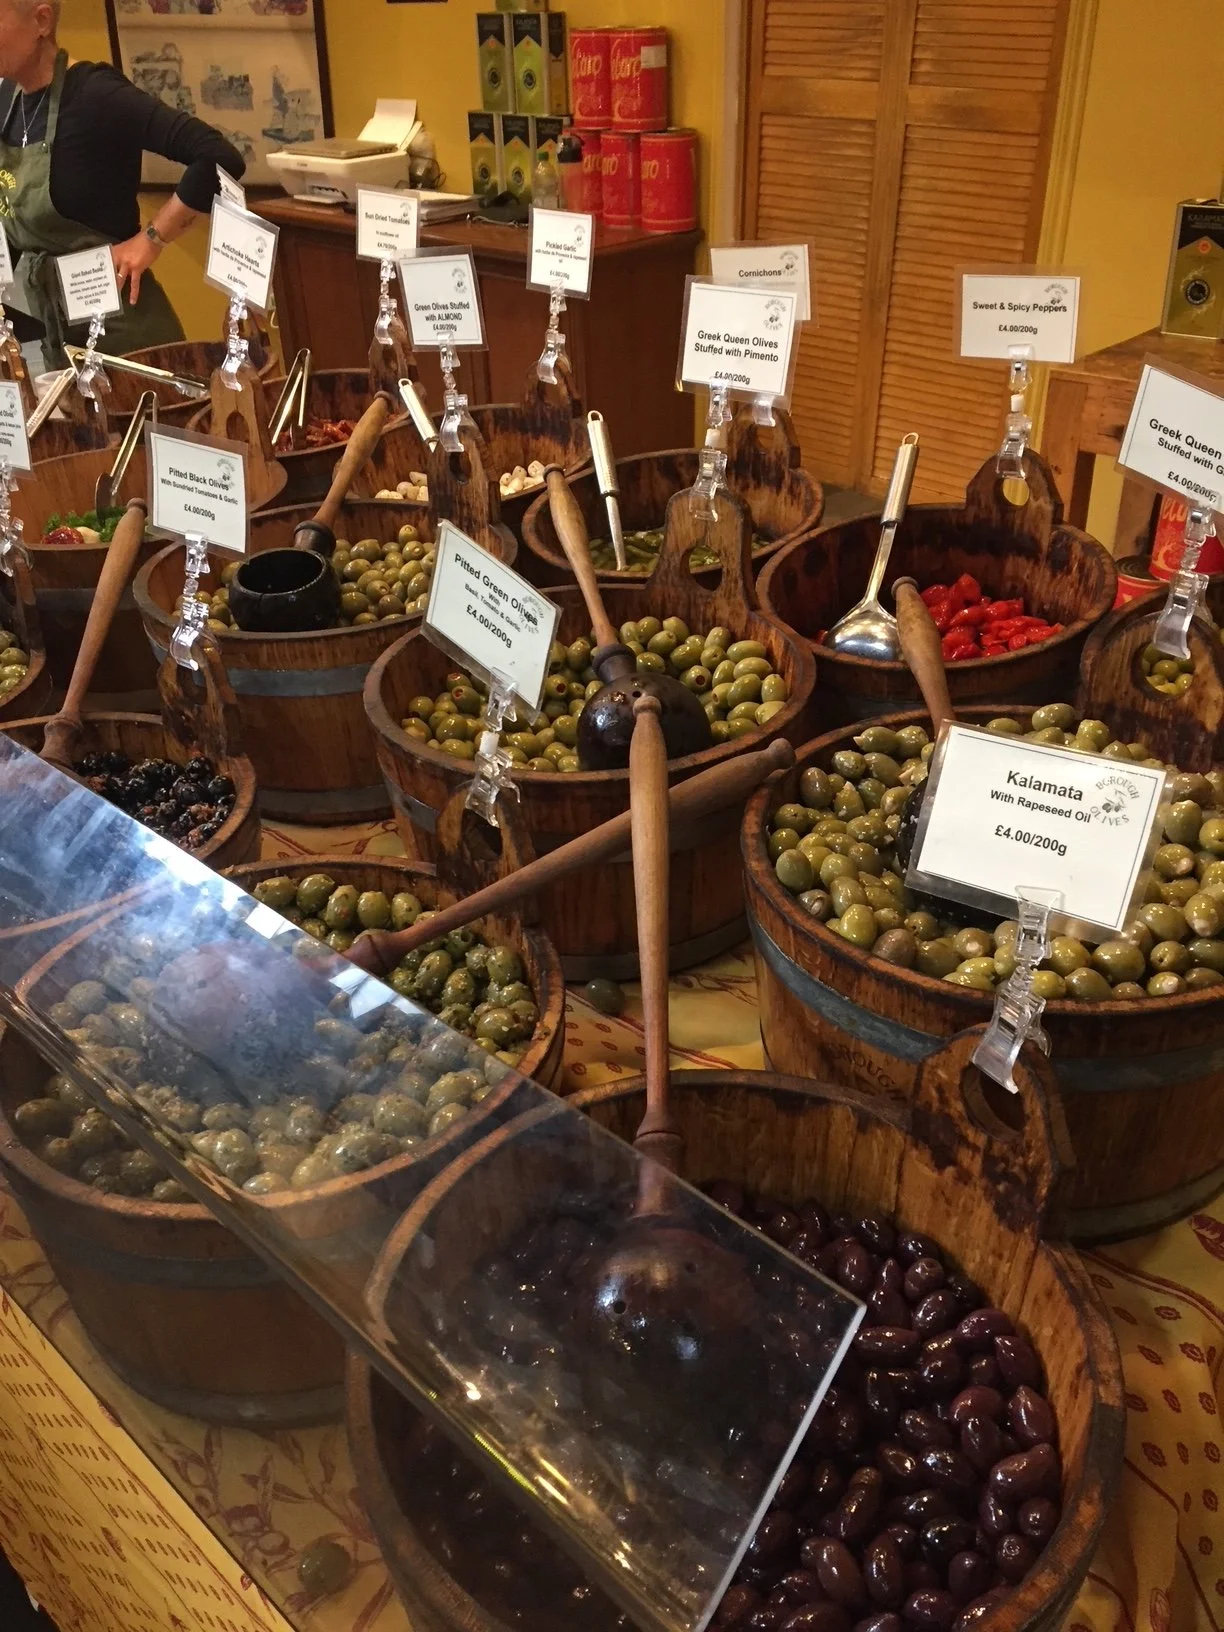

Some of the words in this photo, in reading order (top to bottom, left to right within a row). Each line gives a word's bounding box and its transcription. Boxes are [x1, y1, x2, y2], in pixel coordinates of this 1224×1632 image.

[375, 213, 387, 221] Dried
[388, 216, 410, 225] Tomatoes
[222, 242, 244, 259] Artichoke
[245, 254, 259, 268] Hearts
[546, 241, 562, 250] Pickled
[564, 244, 576, 252] Garlic
[738, 268, 782, 277] Cornichons
[449, 302, 470, 310] Stuffed
[972, 302, 997, 310] Sweet
[999, 302, 1005, 310] &
[1007, 302, 1030, 313] Spicy
[1033, 303, 1067, 313] Peppers
[438, 313, 462, 321] ALMOND
[697, 330, 721, 342] Greek
[723, 333, 749, 345] Queen
[752, 337, 778, 349] Olives
[998, 325, 1038, 335] £4.00/200g
[694, 342, 723, 355] Stuffed
[725, 347, 742, 358] with
[744, 349, 779, 362] Pimento
[714, 370, 750, 385] £4.00/200g
[1149, 418, 1182, 441] Greek
[1185, 435, 1222, 460] Queen
[1158, 437, 1192, 460] Stuffed
[1193, 454, 1214, 470] with
[1216, 465, 1224, 476] G
[169, 467, 188, 479] Pitted
[189, 472, 207, 485] Black
[209, 478, 229, 491] Olives
[161, 478, 172, 486] With
[173, 481, 194, 492] Sundried
[195, 487, 218, 500] Tomatoes
[223, 495, 238, 505] Garlic
[184, 504, 216, 521] £4.00/200g
[454, 553, 481, 580] Pitted
[482, 574, 509, 603] Green
[511, 597, 538, 626] Olives
[488, 592, 501, 606] With
[465, 583, 480, 601] Basil,
[480, 595, 499, 615] Tomato
[500, 611, 505, 619] &
[505, 616, 521, 632] Garlic
[466, 604, 512, 649] £4.00/200g
[1006, 770, 1084, 801] Kalamata
[990, 789, 1015, 804] With
[1017, 797, 1072, 819] Rapeseed
[1075, 810, 1091, 823] Oil
[1090, 806, 1130, 826] OLIVES
[994, 825, 1068, 856] £4.00/200g
